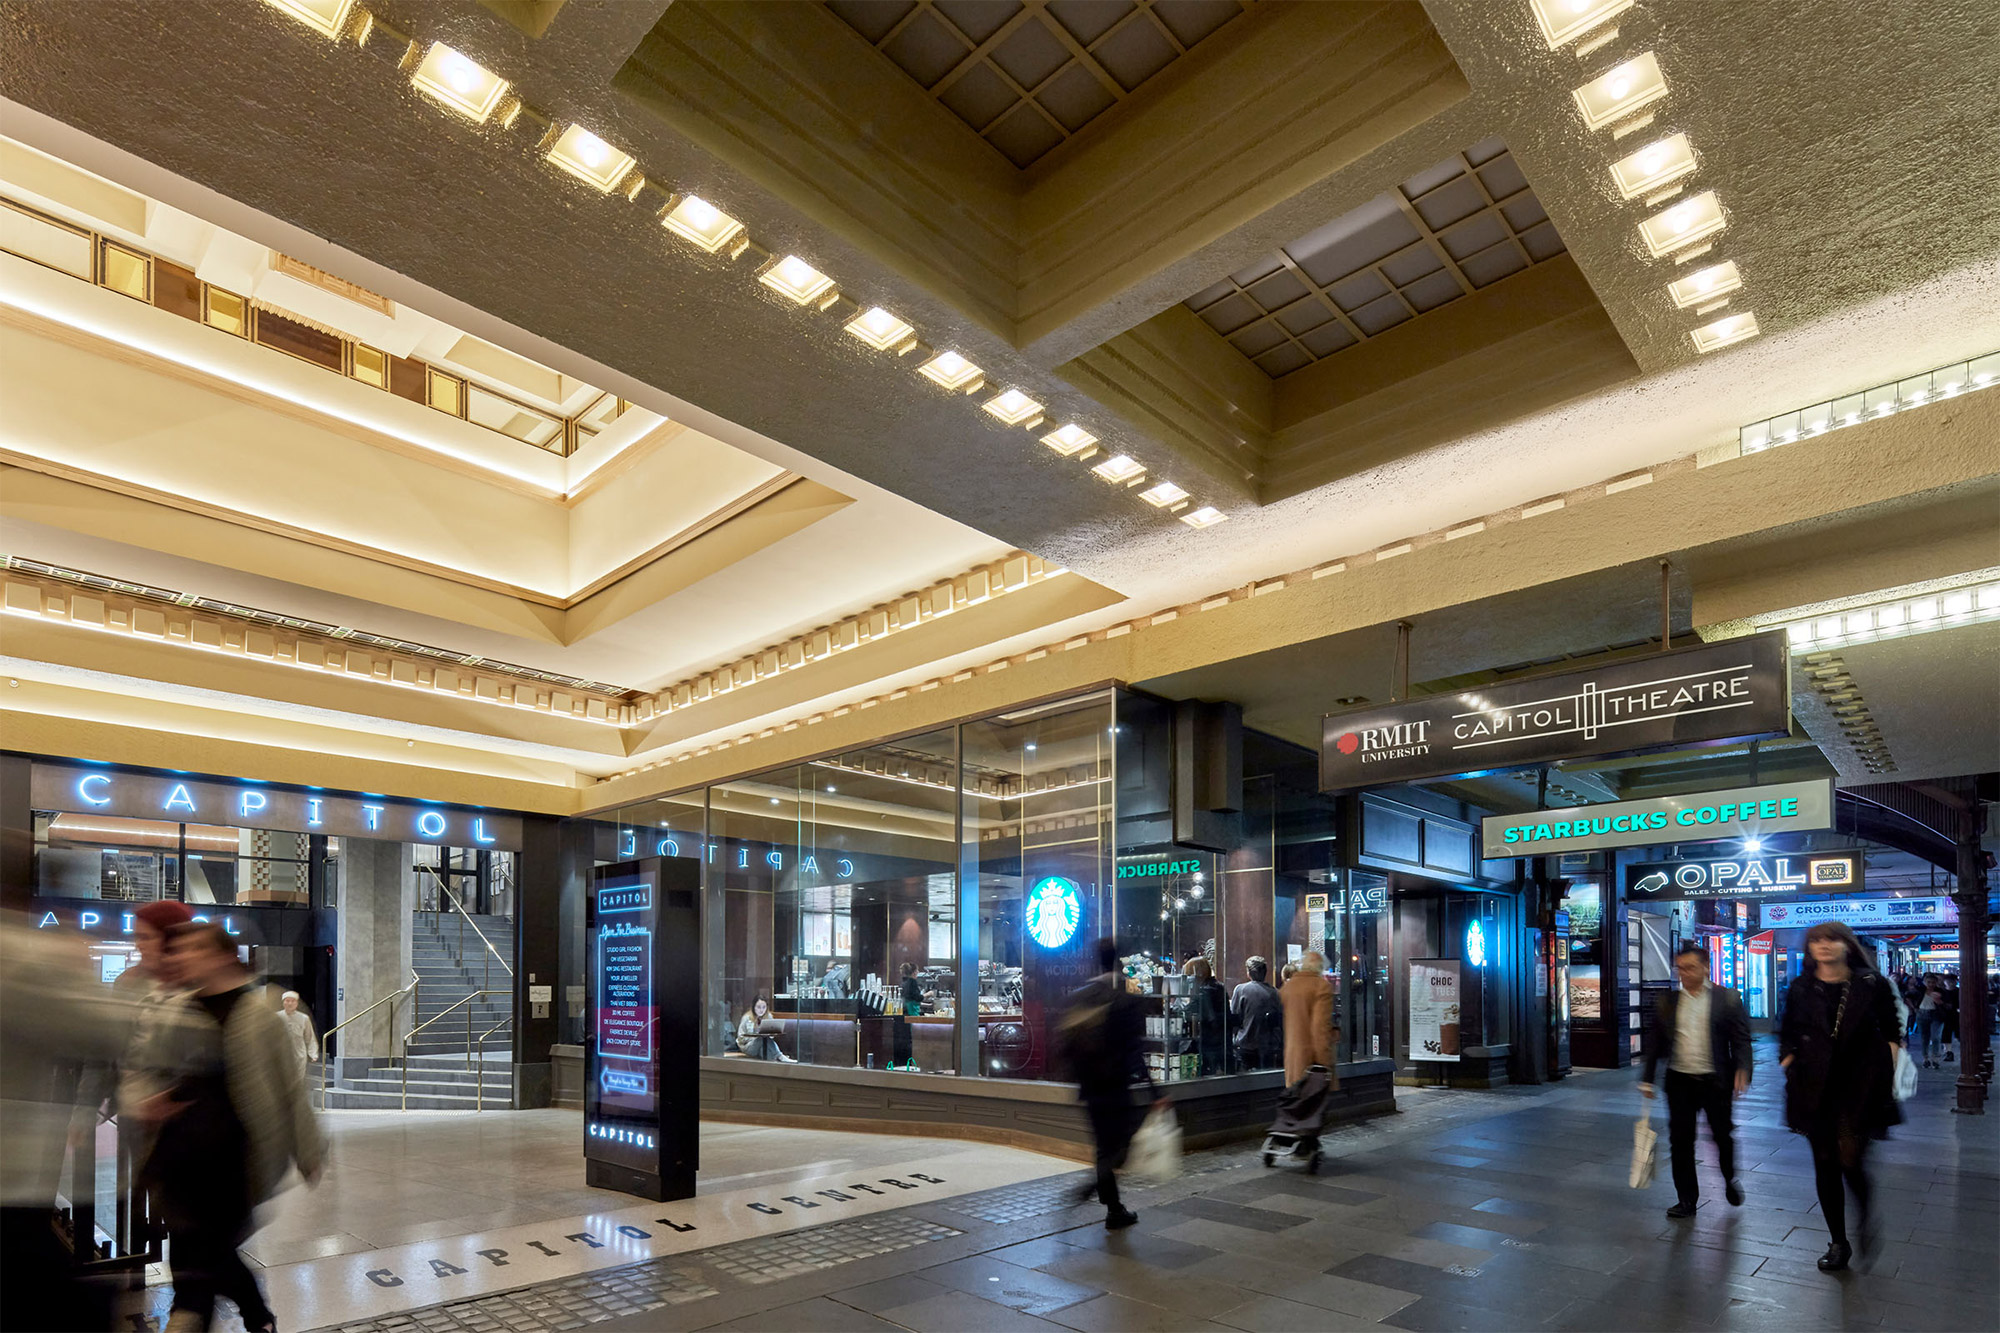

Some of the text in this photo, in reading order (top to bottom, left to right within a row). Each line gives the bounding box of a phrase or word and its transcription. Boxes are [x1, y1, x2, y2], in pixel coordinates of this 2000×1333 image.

[1454, 676, 1749, 740] CAPITOL THEATRE
[1361, 720, 1431, 752] RMIT
[1361, 745, 1431, 764] UNIVERSITY
[79, 775, 495, 842] CAPITOL
[1504, 797, 1799, 843] STARBUCKS COFFEE
[1675, 858, 1807, 889] OPAL
[1818, 868, 1845, 876] OPAL
[602, 892, 647, 906] CAPITOL
[1762, 884, 1796, 892] MUSEUM
[1431, 977, 1452, 986] CHOC
[1436, 987, 1456, 996] TUES
[590, 1124, 654, 1148] CAPITOL
[365, 1172, 947, 1288] CAPITOL CENTRE
